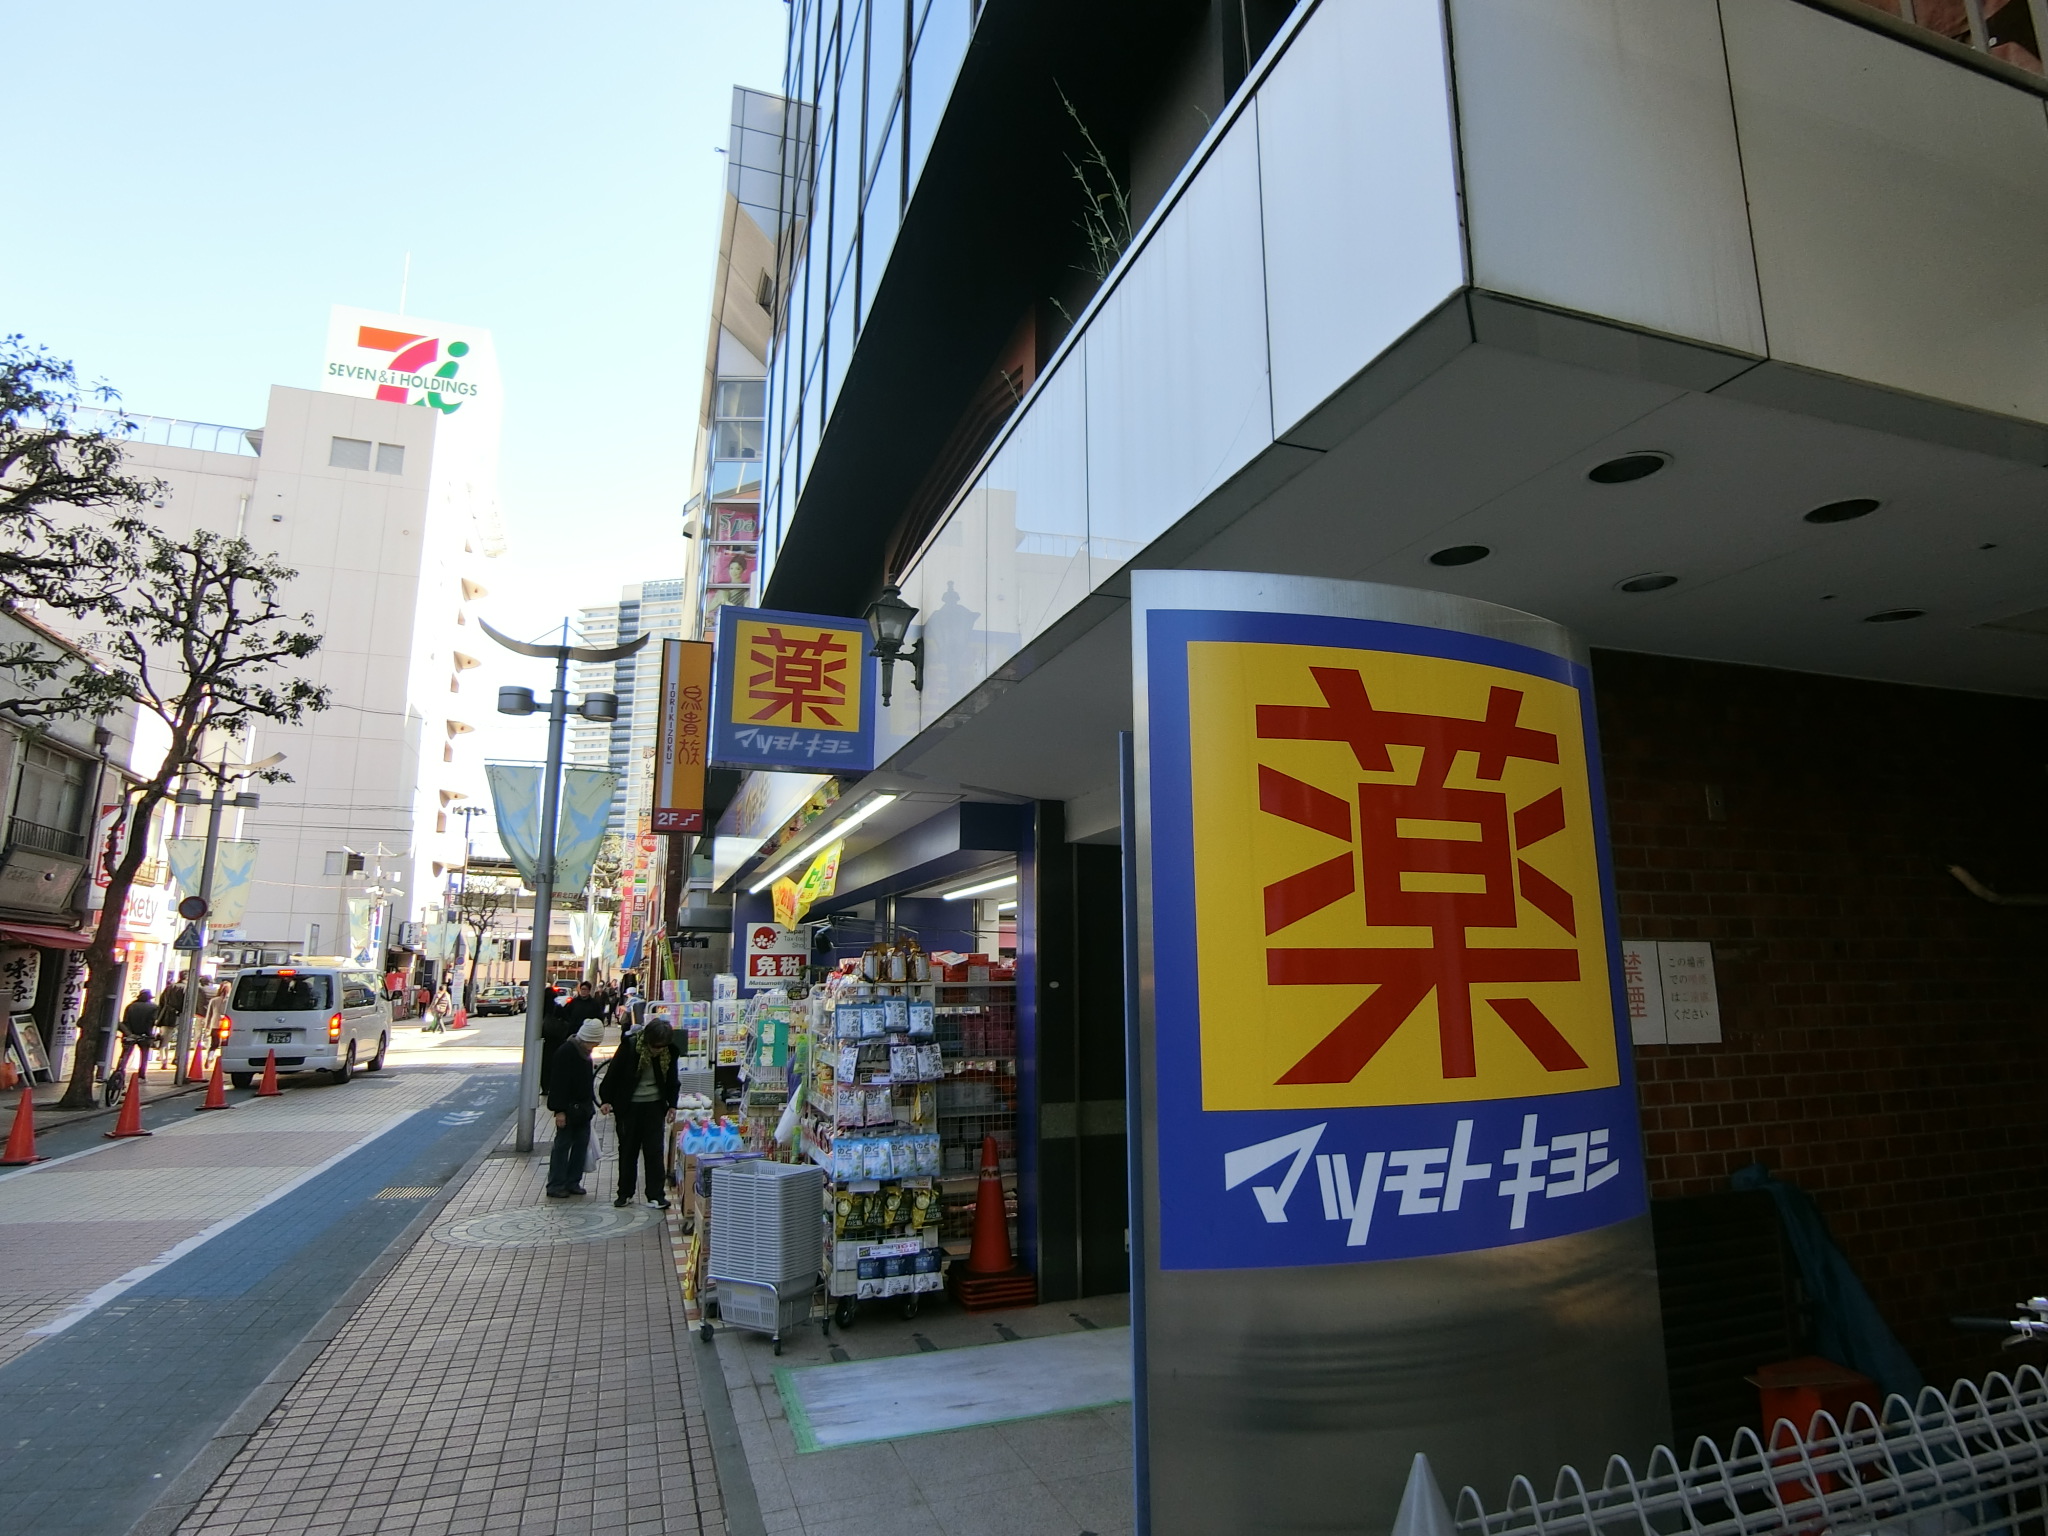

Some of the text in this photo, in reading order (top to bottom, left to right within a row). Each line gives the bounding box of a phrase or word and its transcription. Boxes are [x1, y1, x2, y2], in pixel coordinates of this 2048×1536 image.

[399, 373, 478, 396] HOLDINGS
[720, 511, 756, 537] Spa
[749, 628, 847, 727] 薬
[657, 812, 679, 826] 2F
[1255, 665, 1590, 1086] 薬
[757, 956, 801, 976] 免税
[61, 949, 89, 1026] 切手が安い
[1674, 1009, 1709, 1020] ください
[1224, 1113, 1620, 1247] マツモトキヨシ
